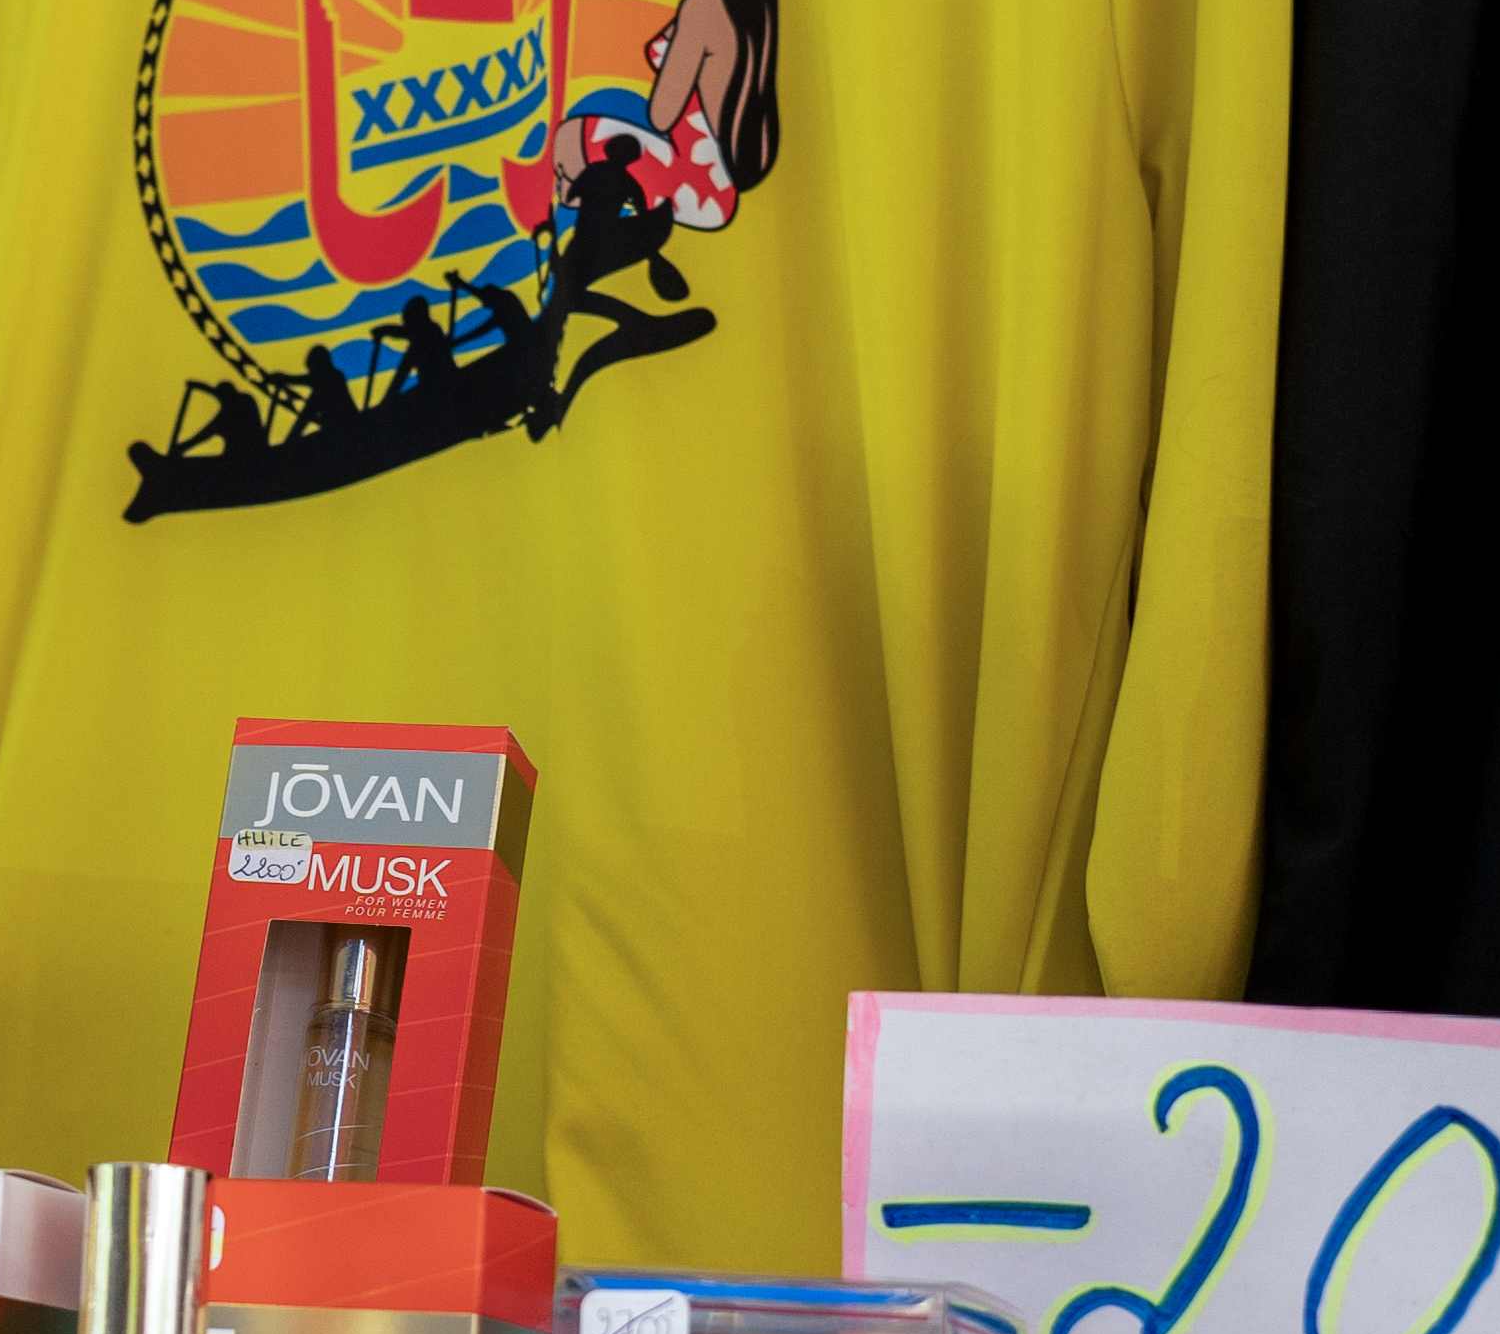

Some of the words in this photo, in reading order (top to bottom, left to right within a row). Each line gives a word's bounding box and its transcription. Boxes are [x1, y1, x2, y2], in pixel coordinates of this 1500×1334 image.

[307, 853, 452, 897] MUSK
[354, 895, 386, 907] FOR
[391, 896, 448, 910] WOMEN
[344, 906, 386, 918] POUR
[392, 908, 447, 921] FEMME
